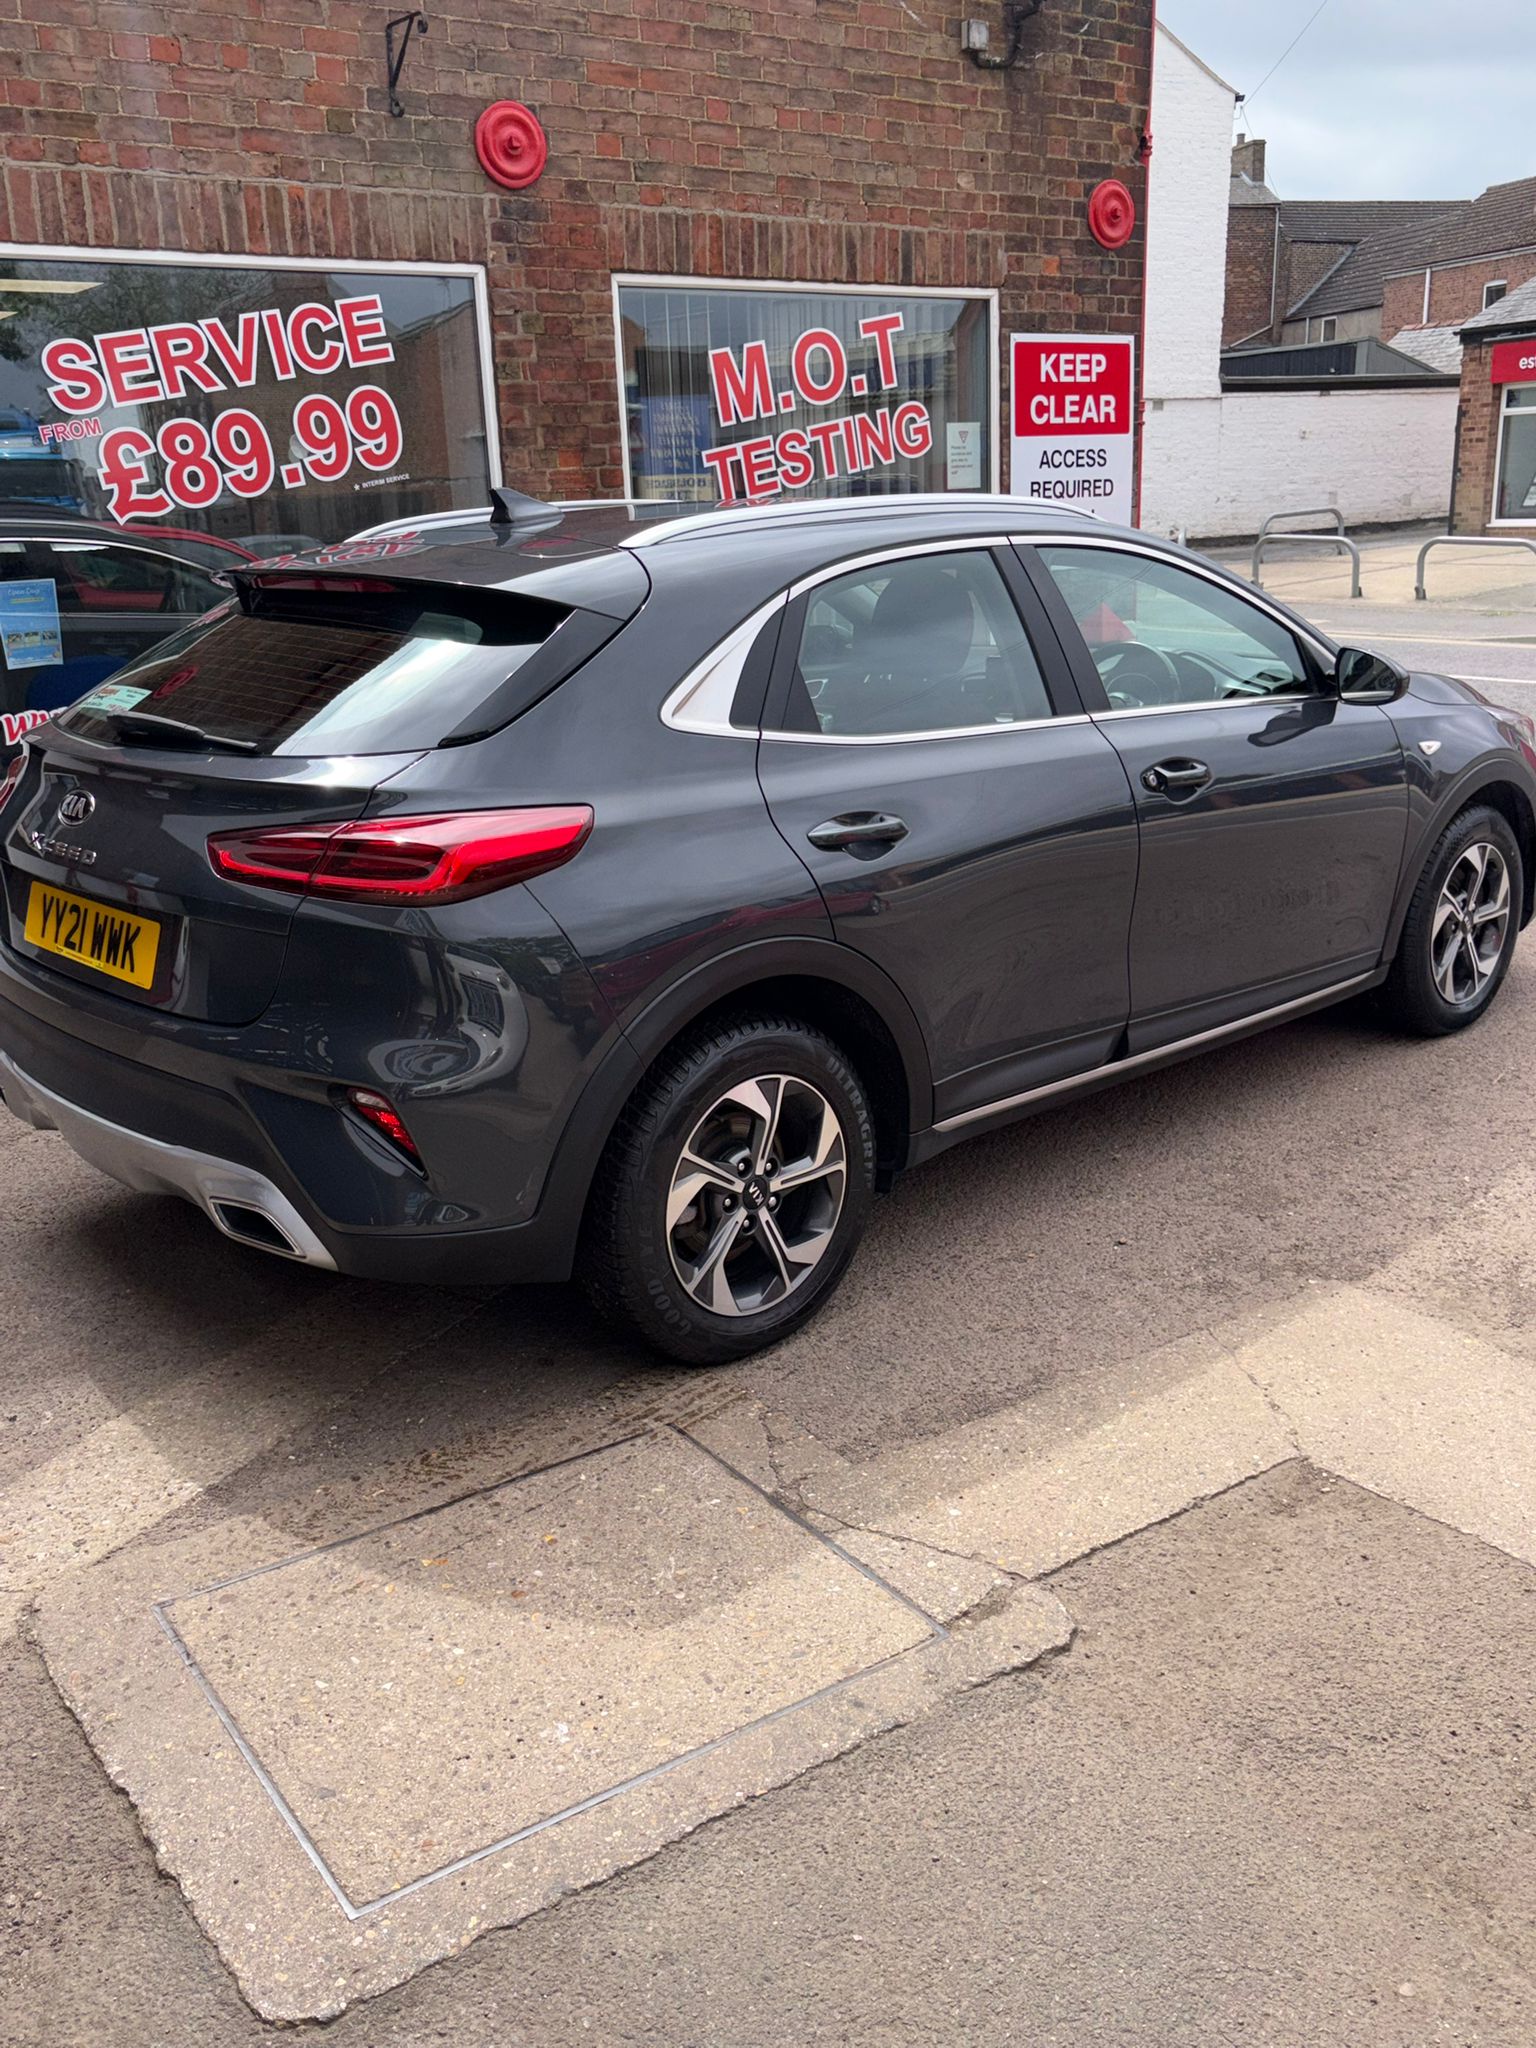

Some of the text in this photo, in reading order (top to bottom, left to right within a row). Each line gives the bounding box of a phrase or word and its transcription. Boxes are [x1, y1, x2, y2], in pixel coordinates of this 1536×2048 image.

[42, 294, 395, 415] SERVICE
[709, 312, 904, 427] M.O.T
[1040, 353, 1107, 383] KEEP
[1030, 394, 1116, 425] CLEAR
[38, 417, 103, 445] FROM
[99, 384, 403, 525] £89.99
[702, 400, 932, 500] TESTING
[1039, 449, 1107, 469] ACCESS
[1031, 479, 1113, 499] REQUIRED
[41, 893, 141, 973] YY21 WWK
[749, 1181, 764, 1206] KIA
